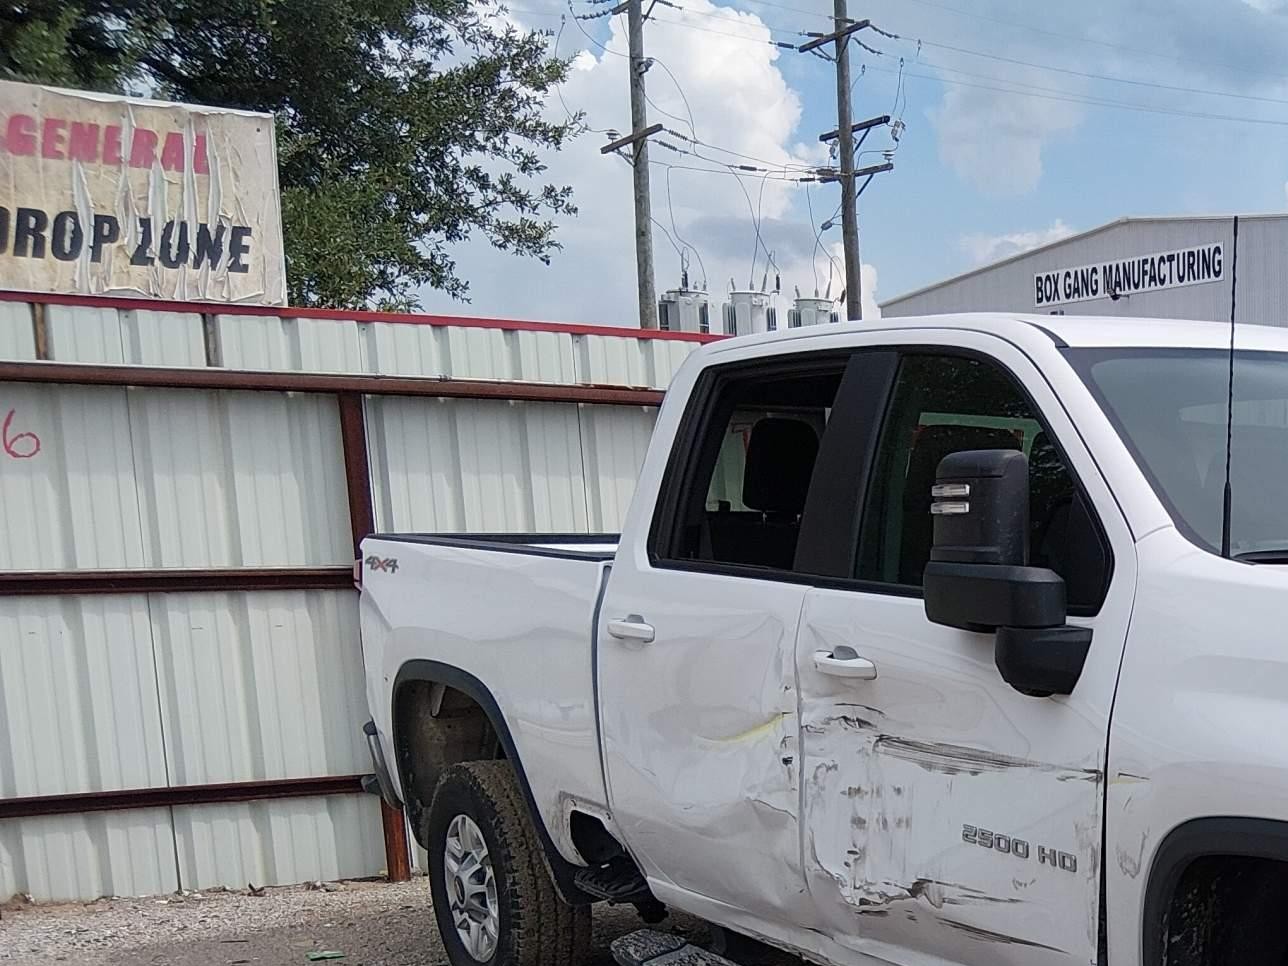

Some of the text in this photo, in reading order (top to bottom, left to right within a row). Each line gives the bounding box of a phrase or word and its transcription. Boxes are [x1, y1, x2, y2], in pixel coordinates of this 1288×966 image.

[7, 114, 210, 175] GENERAL
[129, 216, 252, 274] ZONE
[1035, 245, 1222, 304] BOX GANG MANUFACTURING
[2, 408, 41, 458] 6
[961, 823, 1078, 873] 2500 HD
